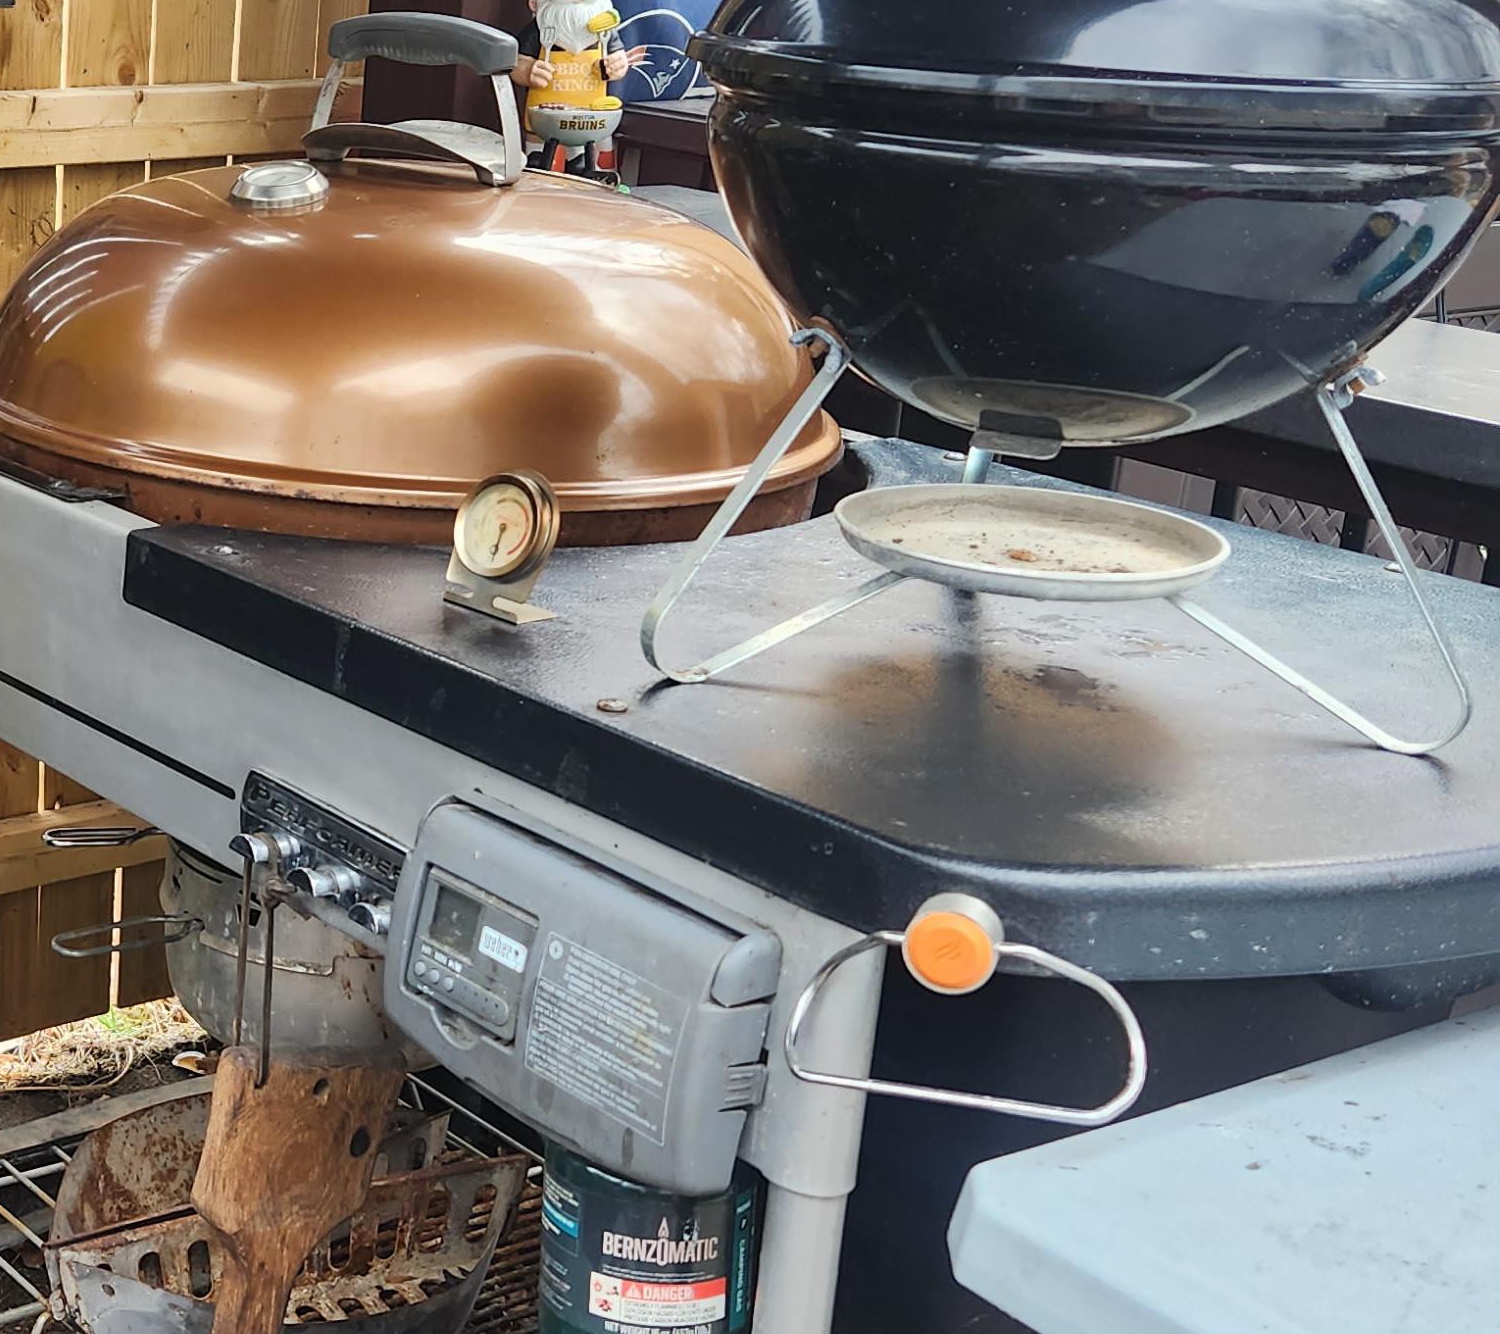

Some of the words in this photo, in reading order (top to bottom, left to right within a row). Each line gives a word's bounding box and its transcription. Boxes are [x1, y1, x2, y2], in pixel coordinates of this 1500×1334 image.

[557, 62, 592, 77] BBQ
[559, 119, 606, 131] BRUINS
[483, 932, 514, 959] weber
[602, 1230, 719, 1267] BERNZOMATIC
[642, 1285, 694, 1301] DANGER
[604, 1321, 619, 1334] NET
